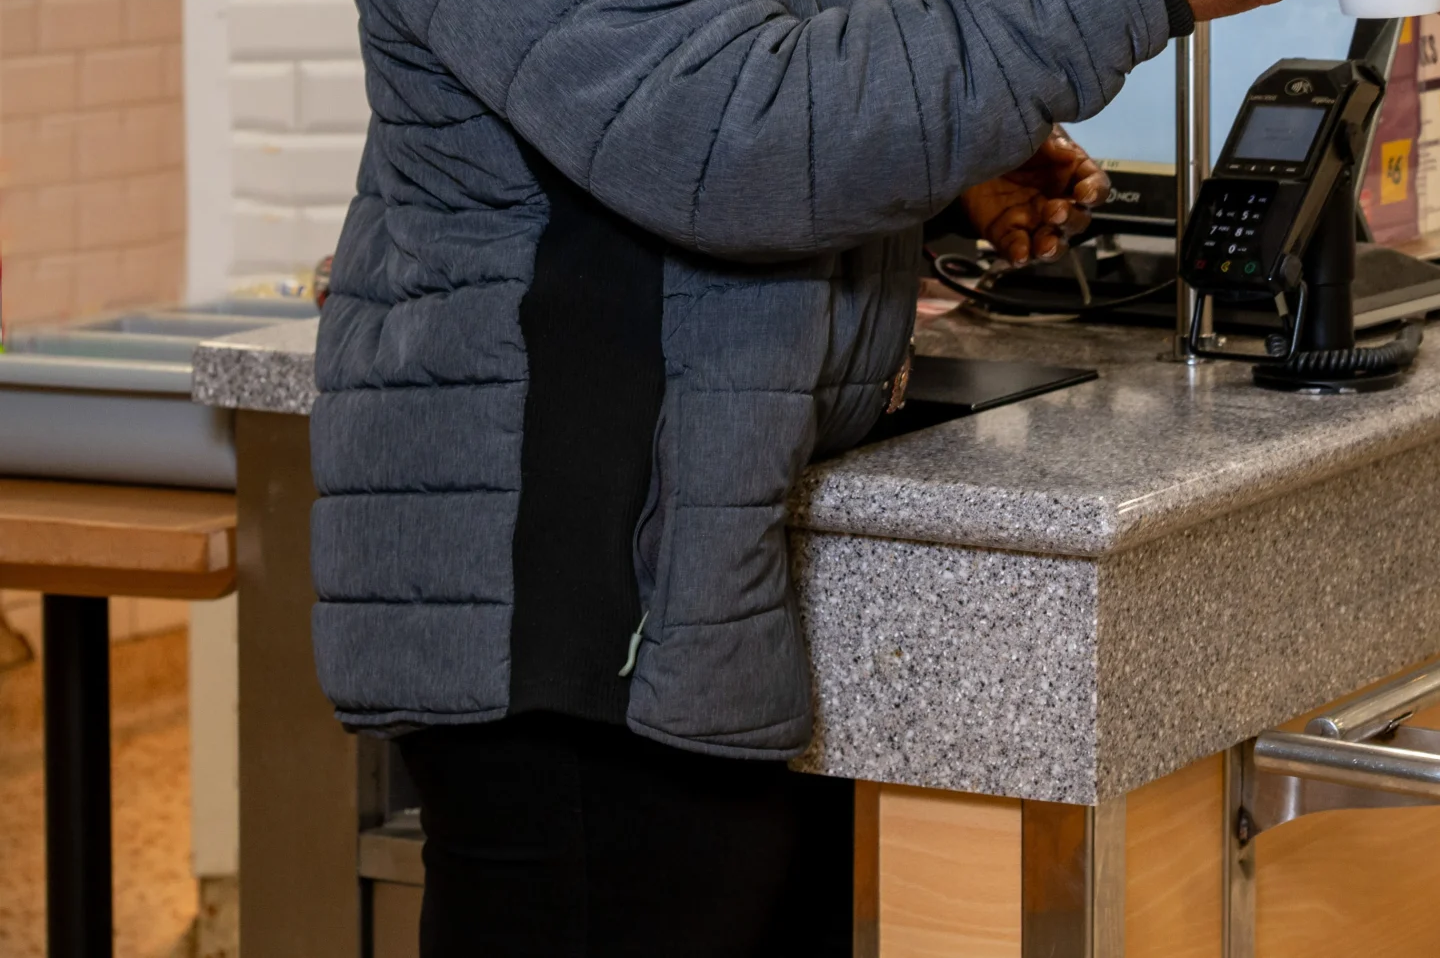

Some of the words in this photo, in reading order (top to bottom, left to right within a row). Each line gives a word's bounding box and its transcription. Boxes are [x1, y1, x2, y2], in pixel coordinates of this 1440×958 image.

[1118, 192, 1141, 203] NCR
[1248, 194, 1256, 204] 2
[1241, 210, 1250, 221] 5
[1234, 227, 1244, 237] 8
[1228, 243, 1237, 254] 0
